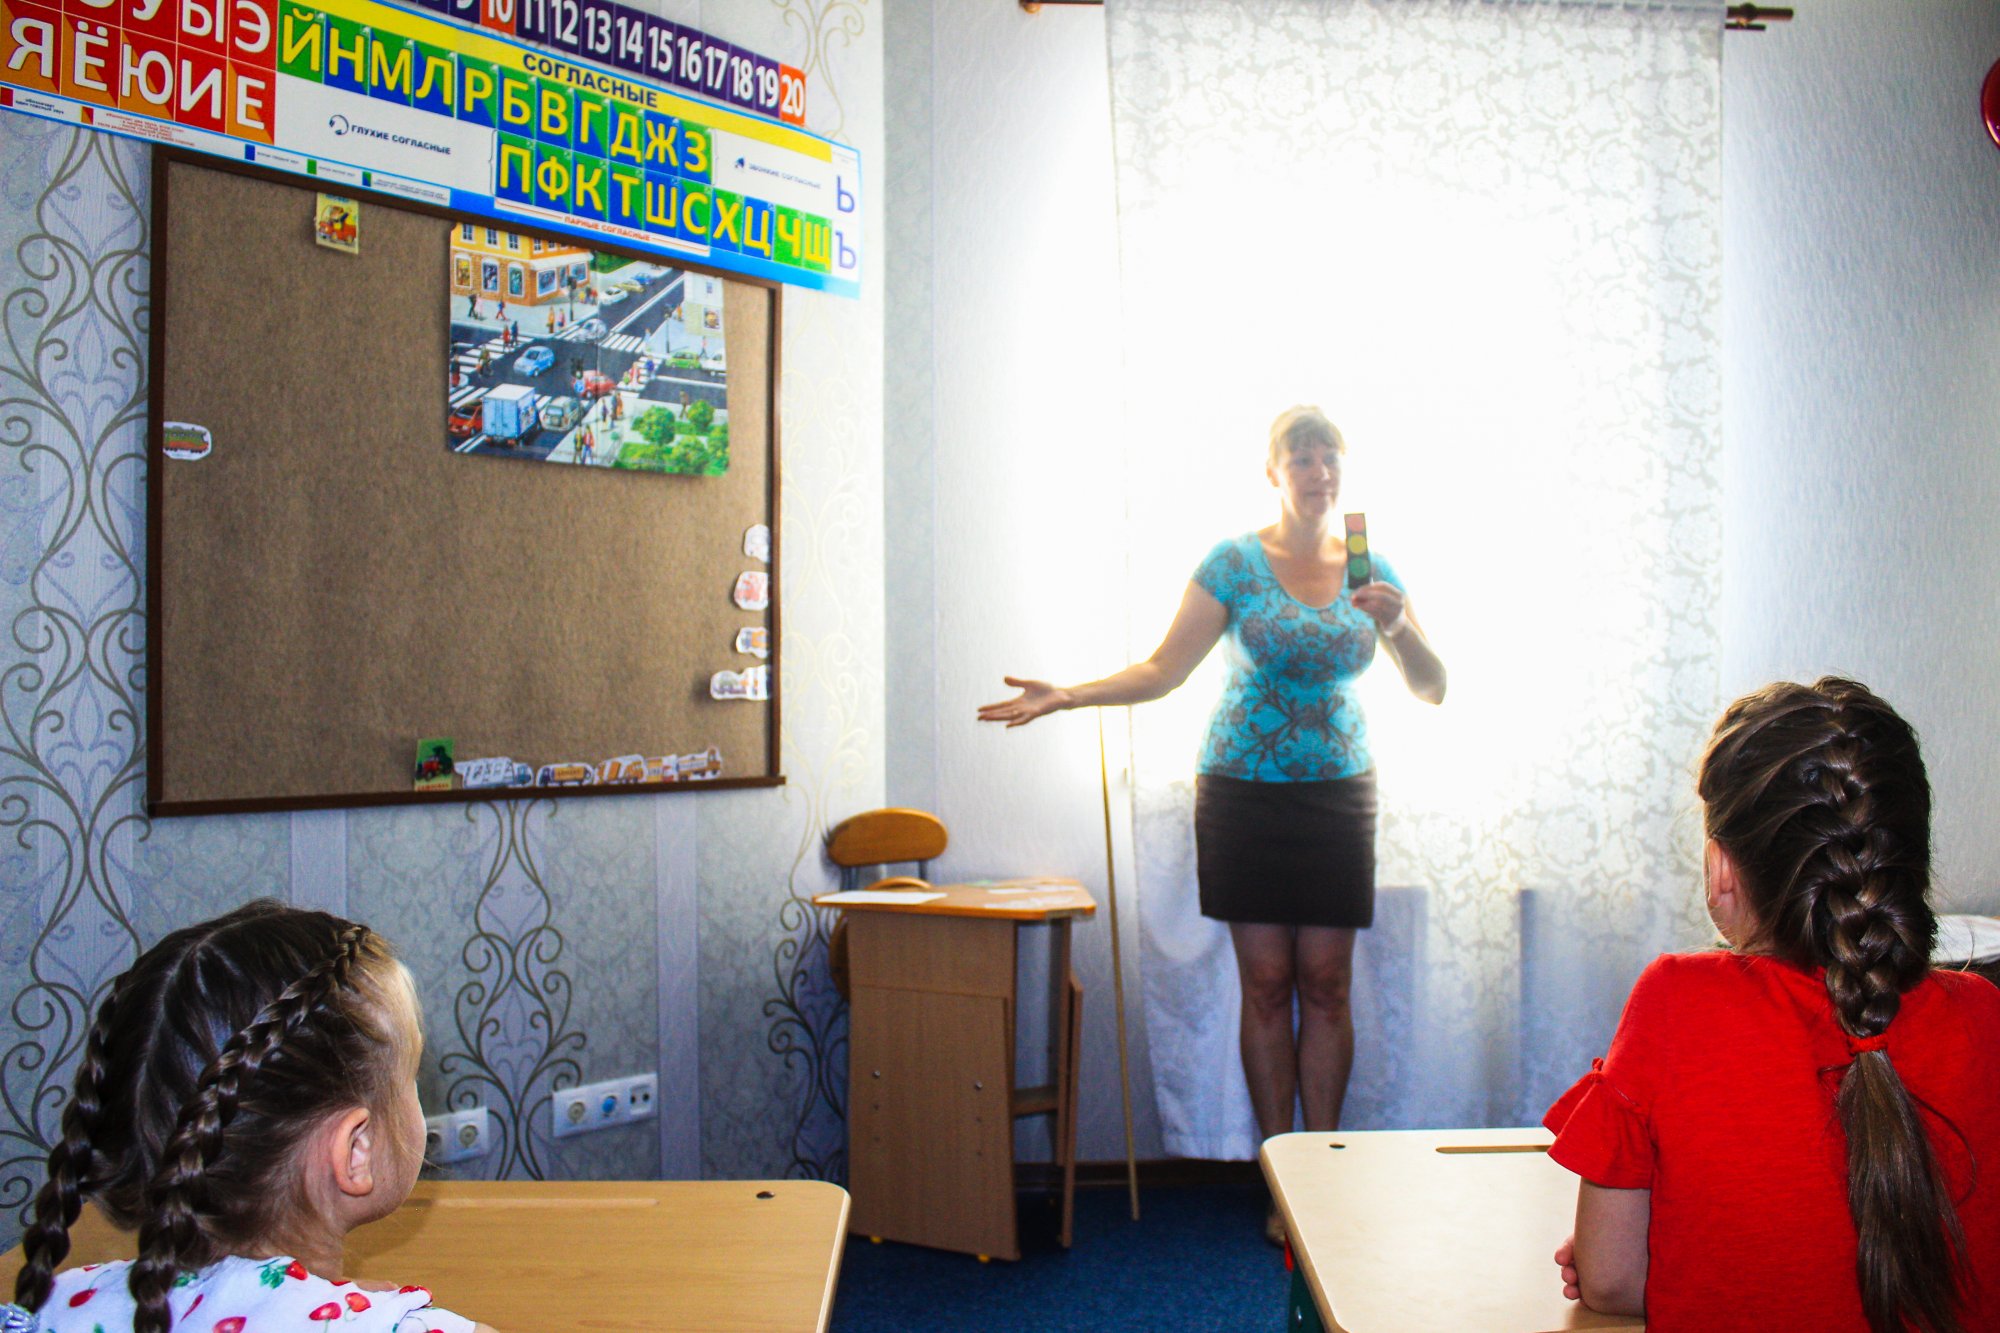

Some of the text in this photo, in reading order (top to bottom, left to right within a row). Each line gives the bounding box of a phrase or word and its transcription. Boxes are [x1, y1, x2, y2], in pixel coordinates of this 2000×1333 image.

[181, 0, 226, 44] Ы
[234, 0, 272, 54] Э
[7, 16, 54, 79] Я
[73, 19, 110, 92] Ё
[120, 42, 175, 106] Ю
[179, 58, 223, 120] И
[235, 74, 266, 131] Е
[521, 53, 658, 109] СОГЛАСНЫЕ
[551, 0, 580, 45] 12
[583, 6, 612, 54] 13
[615, 15, 644, 64] 14
[647, 25, 674, 73] 15
[676, 35, 703, 83] 16
[703, 45, 730, 91] 17
[729, 54, 755, 101] 18
[755, 64, 781, 109] 19
[780, 73, 805, 118] 20
[281, 6, 708, 173] Й Н М Л Р Б В Г Д Ж З
[350, 124, 452, 156] ГЛУХИЕ СОГЛАСНЫЕ
[498, 143, 531, 194] П
[536, 155, 570, 201] Ф
[575, 163, 603, 211] К
[611, 172, 641, 217] Т
[644, 181, 678, 228] Ш
[681, 191, 708, 235] С
[712, 198, 740, 243] Х
[743, 205, 772, 257] Ц
[777, 214, 802, 258] Ч
[803, 222, 832, 271] Щ
[836, 175, 855, 214] Ь
[563, 215, 651, 242] ПАРНЫЕ СОГЛАСНЫЕ
[835, 230, 857, 271] Ъ
